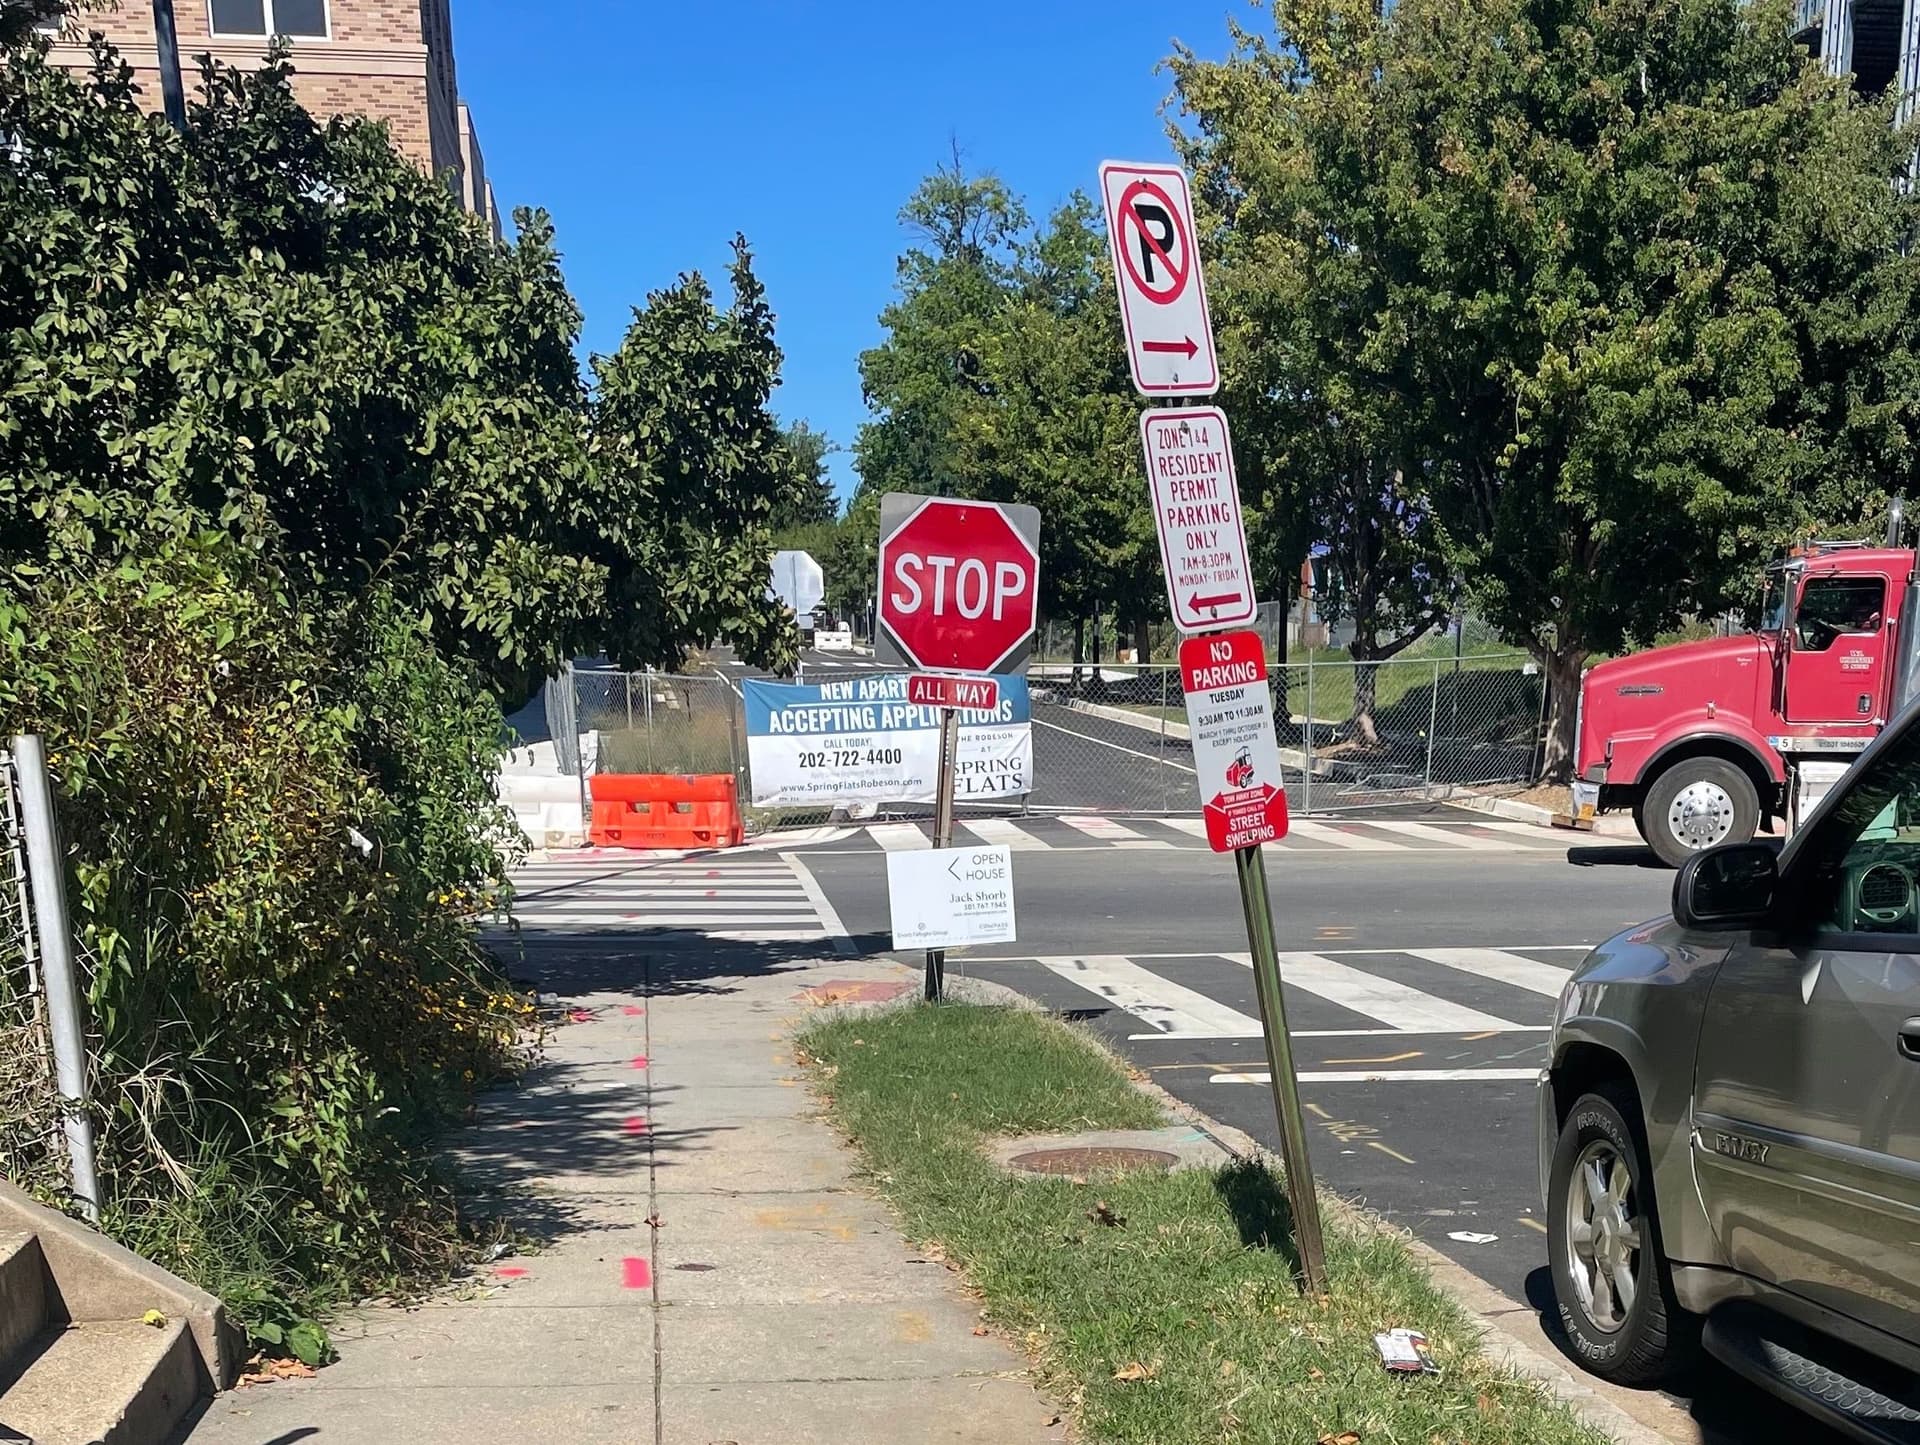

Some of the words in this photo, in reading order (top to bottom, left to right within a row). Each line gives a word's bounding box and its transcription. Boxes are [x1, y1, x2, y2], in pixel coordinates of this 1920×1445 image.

[1157, 427, 1186, 450] ZONE
[1201, 427, 1209, 447] 4
[1159, 452, 1223, 477] RESIDENT
[1170, 478, 1218, 502] PERMIT
[1167, 503, 1230, 529] PARKING
[1186, 530, 1217, 551] ONLY
[891, 552, 1026, 621] STOP
[1210, 641, 1233, 663] NO
[1192, 661, 1257, 688] PARKING
[820, 681, 854, 700] NEW
[914, 681, 945, 700] ALL
[955, 682, 990, 704] WAY
[1209, 688, 1245, 704] TUESDAY
[769, 705, 875, 733] ACCEPTING
[1198, 712, 1224, 726] 9:30AM
[1224, 710, 1235, 720] TO
[1236, 705, 1264, 719] 11:30AM
[824, 739, 842, 749] CALL
[975, 733, 1014, 742] ROBESON
[1212, 737, 1232, 748] EXCEPT
[1782, 739, 1789, 748] 5
[798, 748, 902, 769] 202-722-4400
[781, 777, 922, 793] www.SpringFlatsRobeson.com
[1230, 812, 1266, 831] STREET
[972, 853, 1004, 865] OPEN
[966, 868, 1005, 880] HOUSE
[949, 892, 973, 903] Jack
[976, 890, 1006, 901] Shorb
